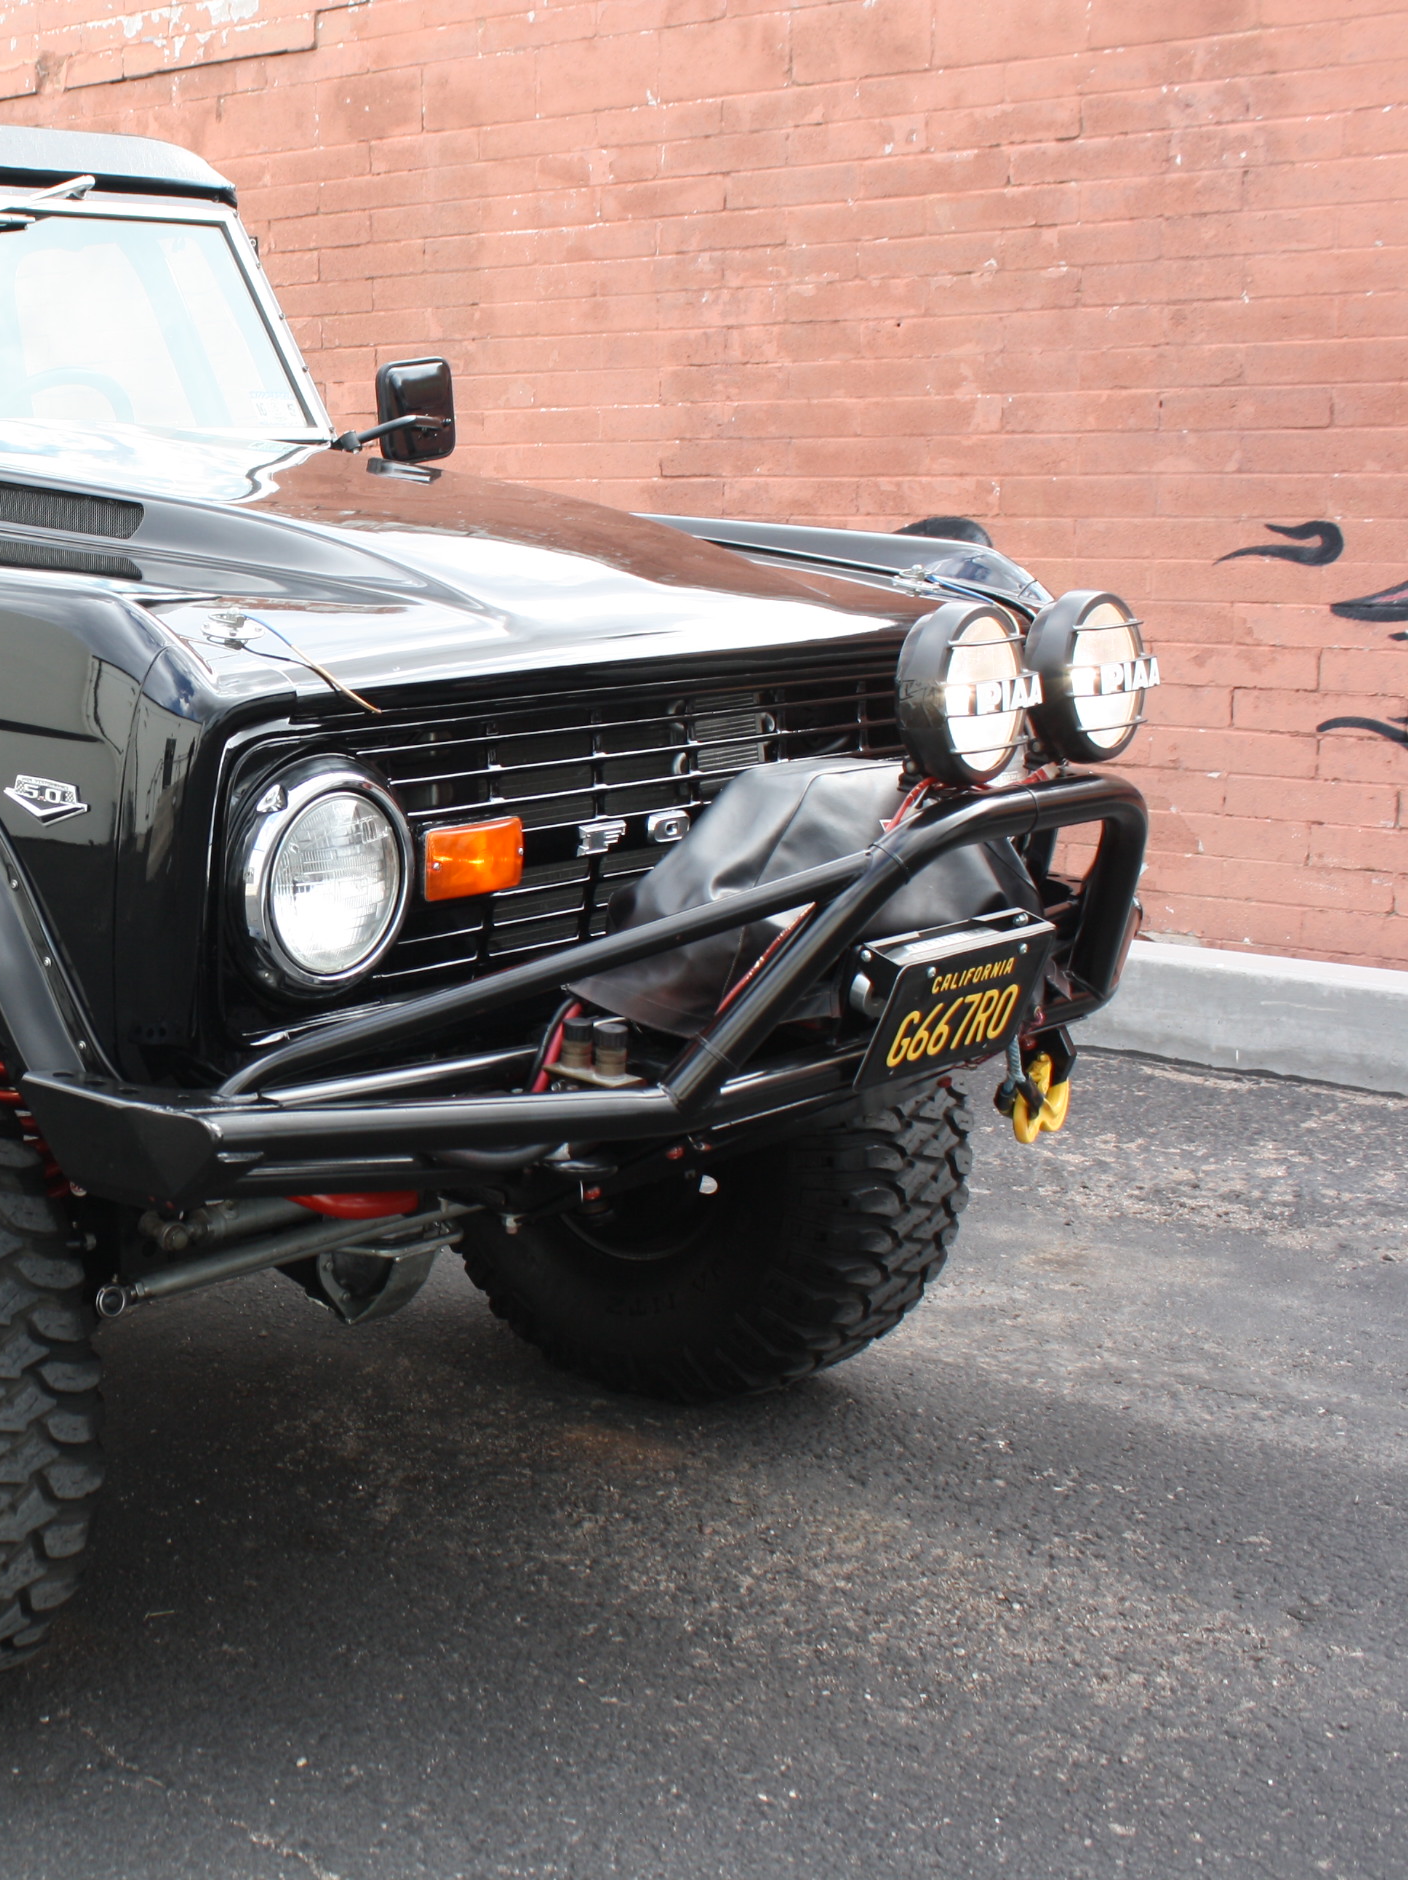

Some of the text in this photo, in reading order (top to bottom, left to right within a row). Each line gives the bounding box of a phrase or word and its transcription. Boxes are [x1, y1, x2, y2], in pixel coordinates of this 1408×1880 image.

[976, 673, 1043, 716] PIAA
[1101, 656, 1161, 695] PIAA
[931, 957, 1015, 995] CALIFORNIA
